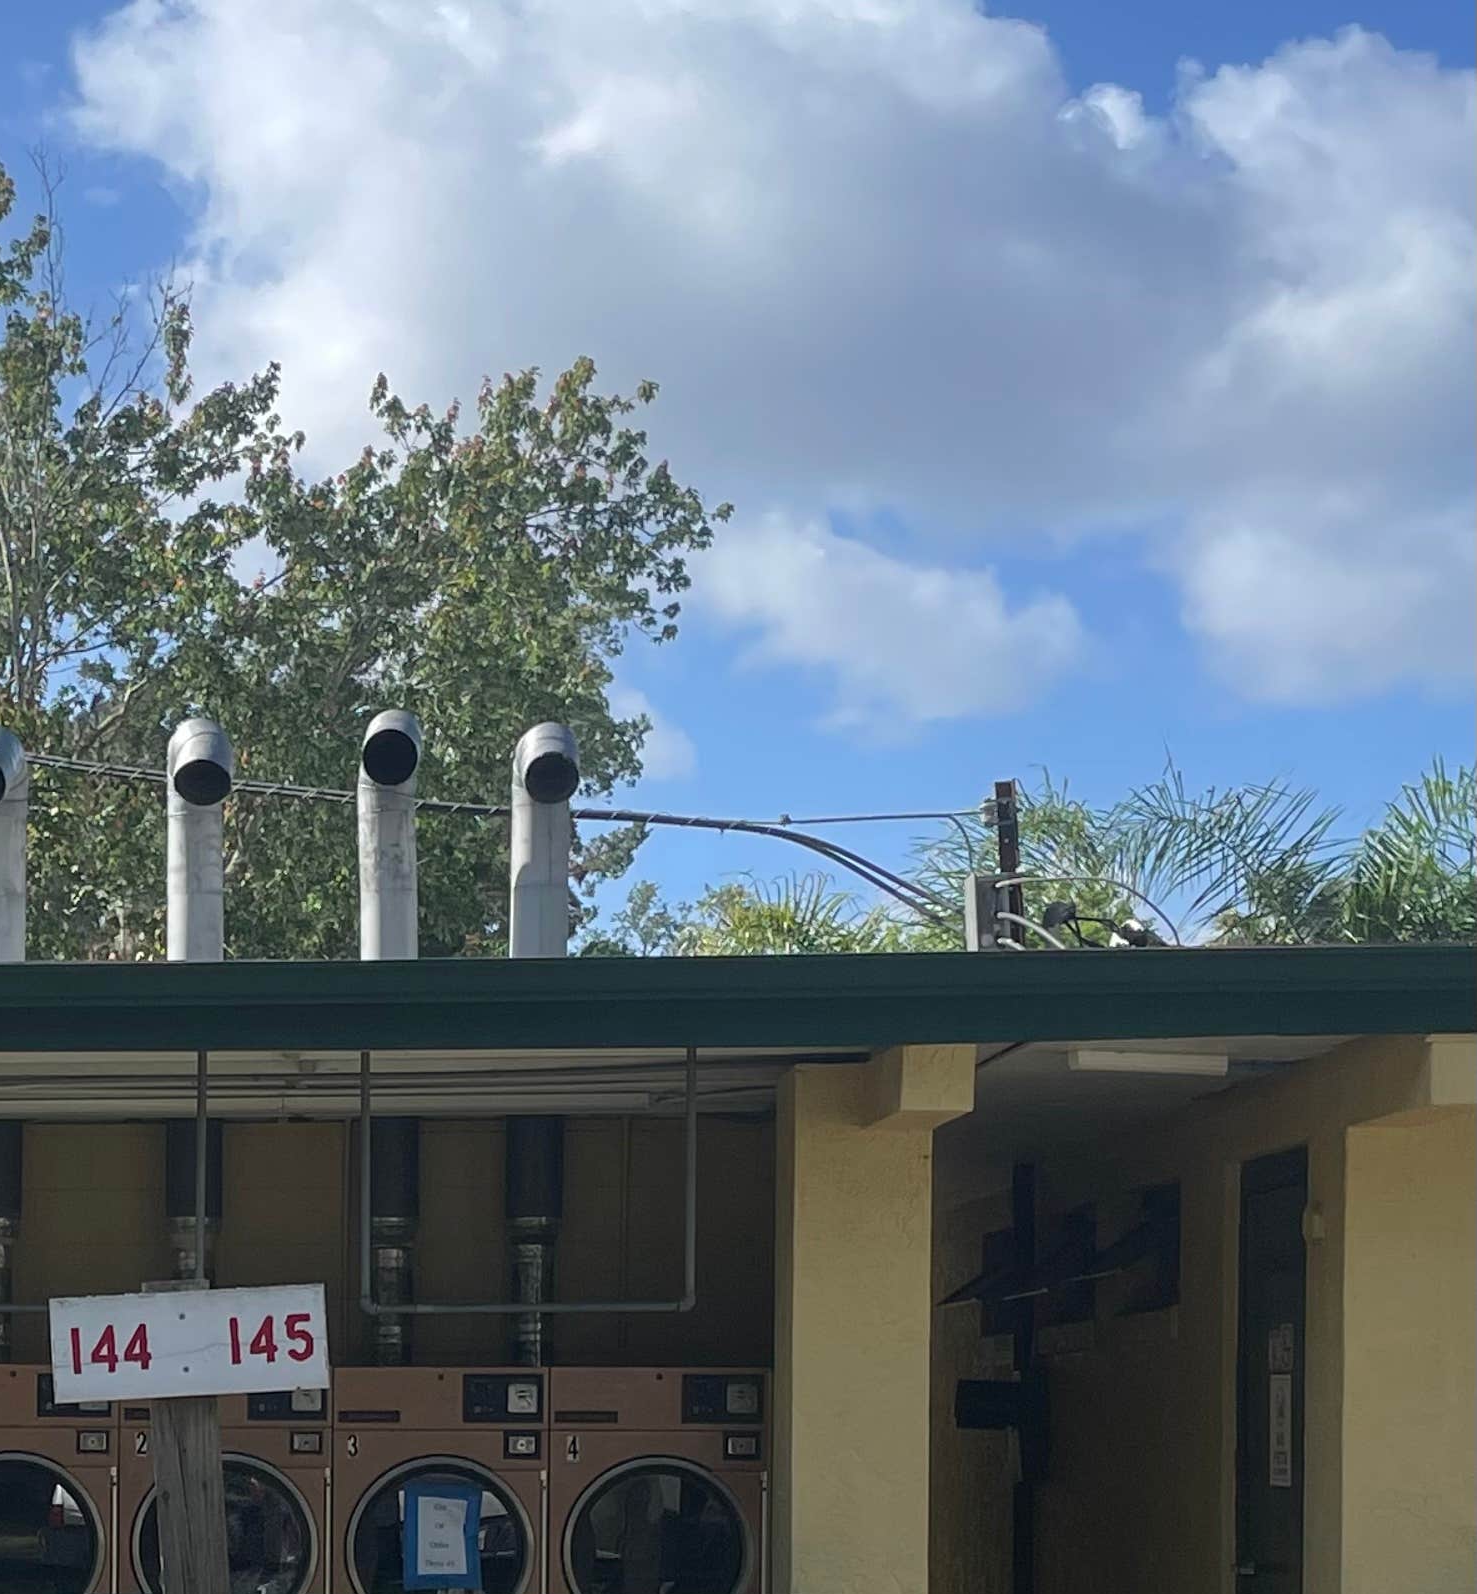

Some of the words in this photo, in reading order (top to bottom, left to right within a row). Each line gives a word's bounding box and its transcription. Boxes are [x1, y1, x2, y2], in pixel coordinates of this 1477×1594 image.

[70, 1323, 152, 1374] 144
[229, 1313, 314, 1365] 145
[137, 1432, 146, 1454] 2
[347, 1435, 359, 1457] 3
[568, 1435, 579, 1459] 4
